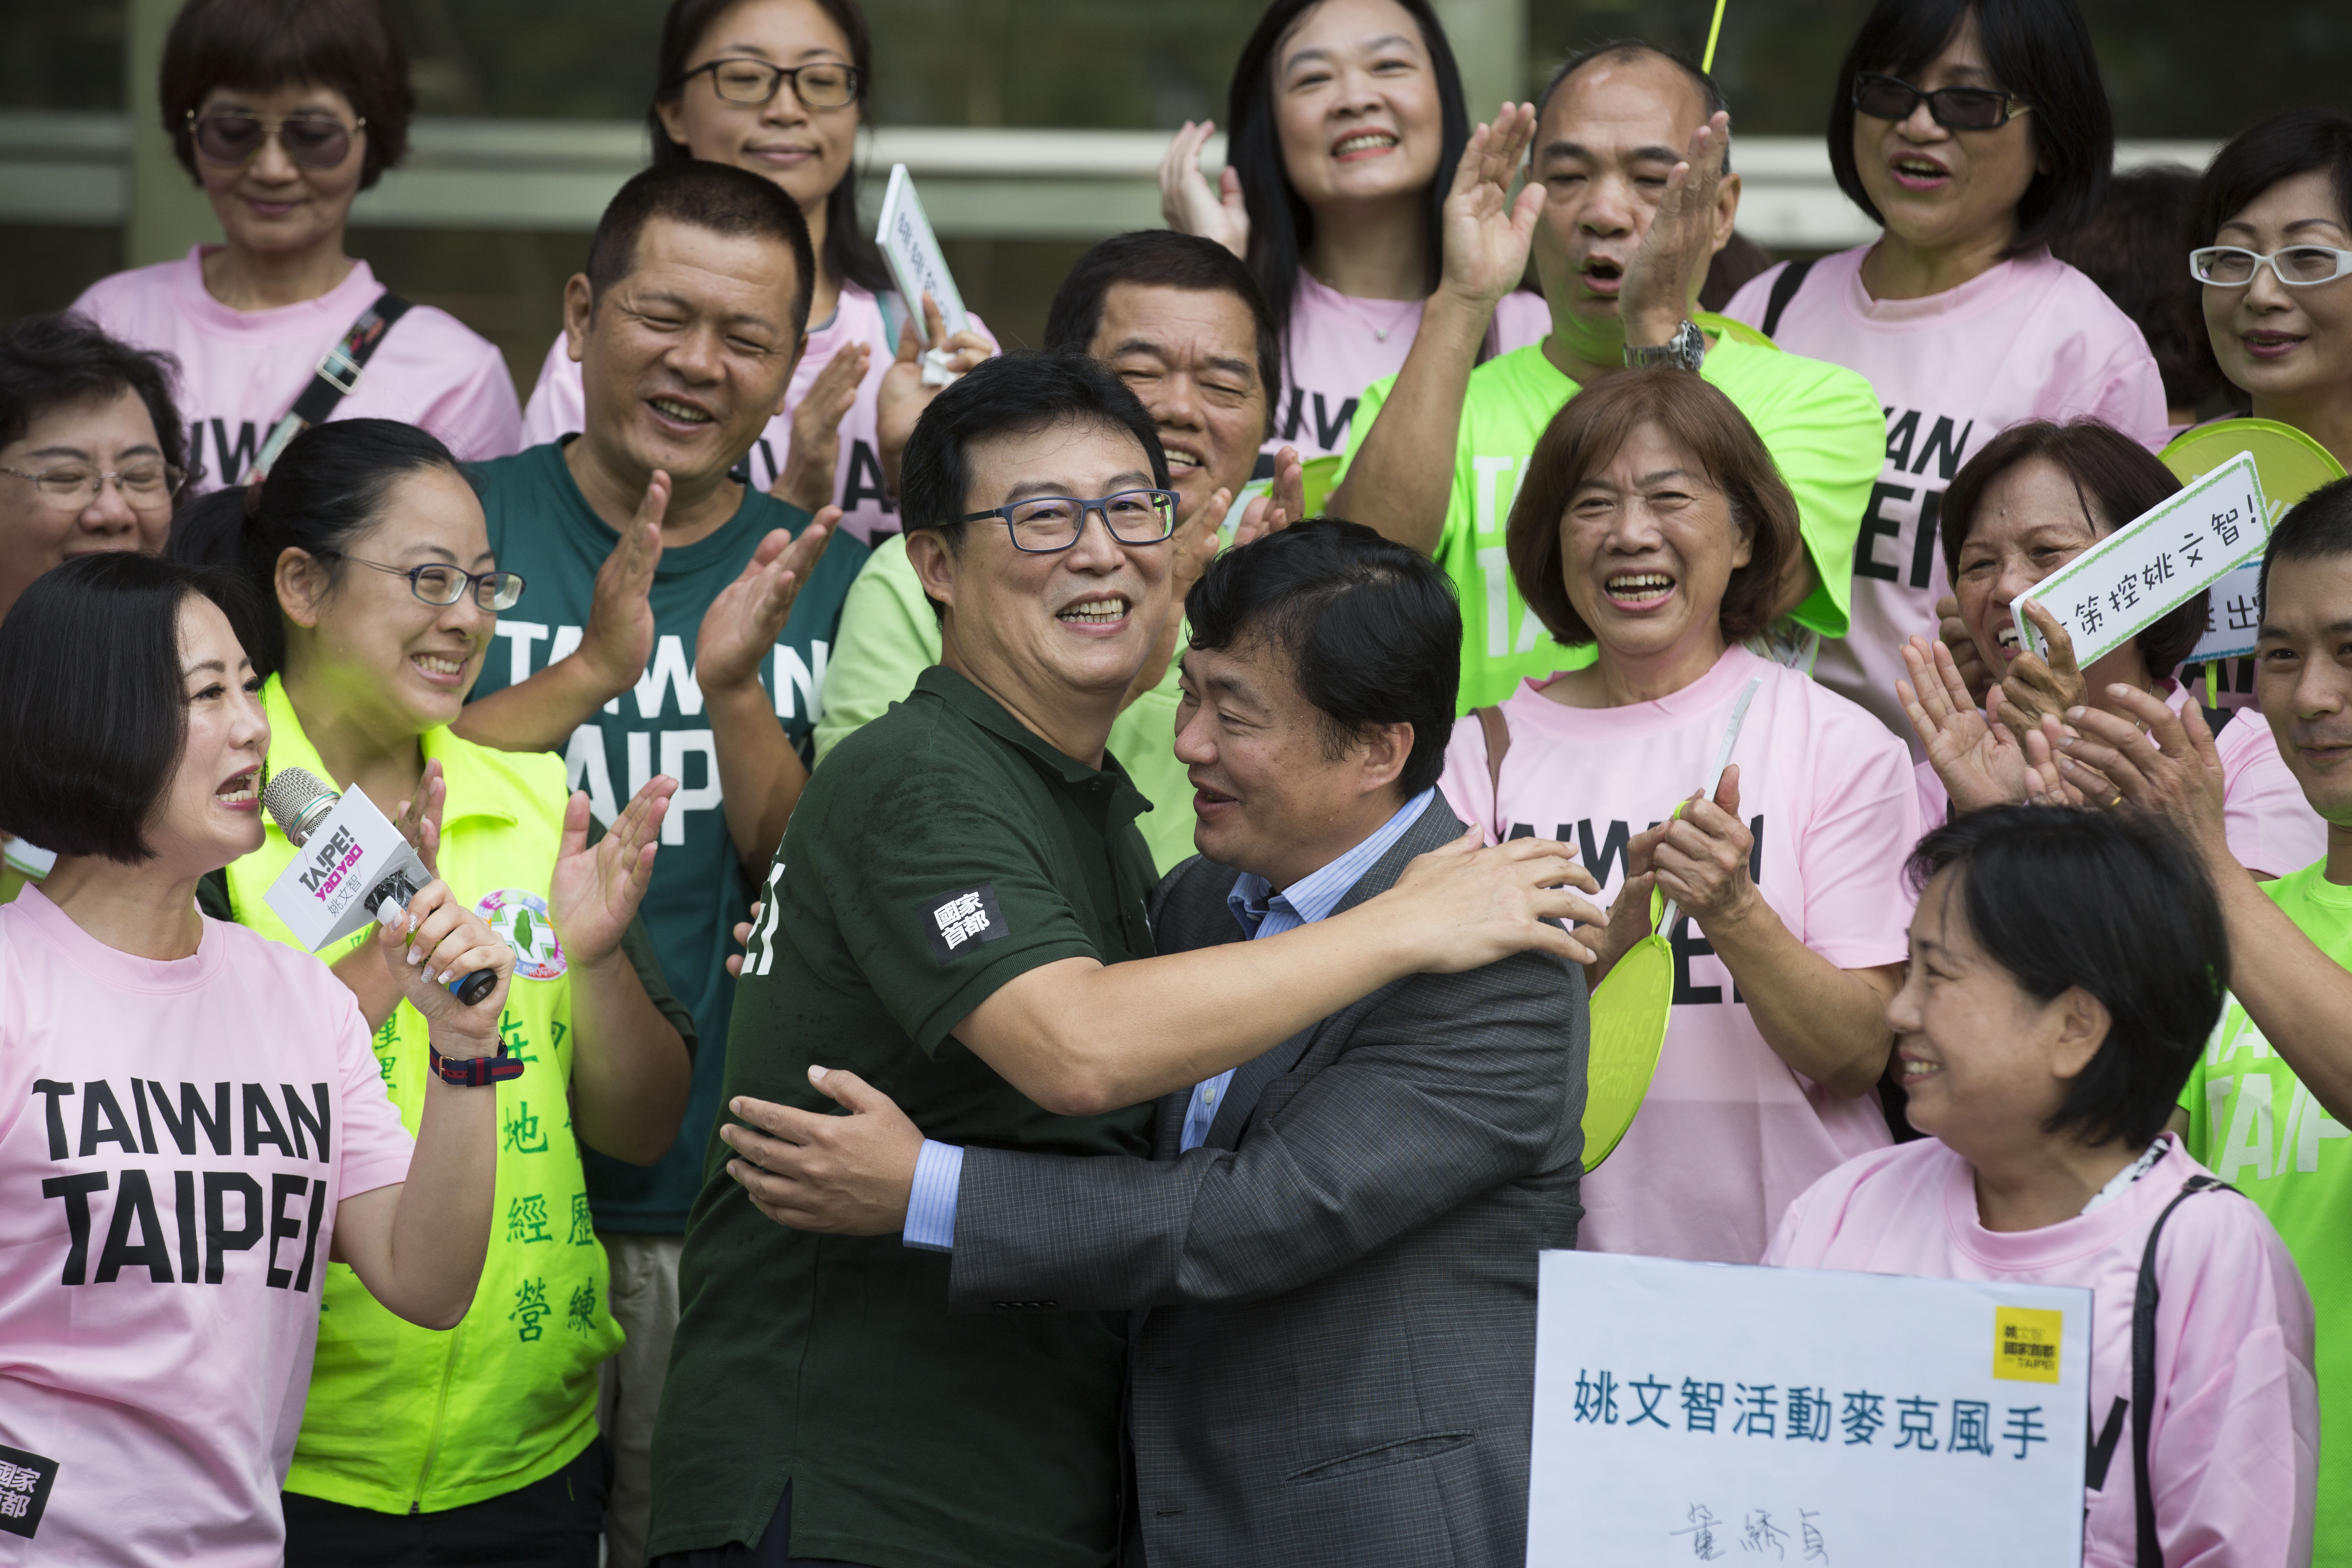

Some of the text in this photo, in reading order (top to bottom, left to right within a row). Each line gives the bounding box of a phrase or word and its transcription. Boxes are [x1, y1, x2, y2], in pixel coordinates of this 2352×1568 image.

[2040, 494, 2256, 657] 策控姚文智!
[495, 620, 829, 723] TWN
[327, 874, 362, 918] 姚文智
[933, 891, 983, 931] 國家
[941, 909, 990, 950] 首都
[33, 1077, 331, 1163] TAIWAN
[2206, 1072, 2352, 1184] TAIP
[499, 1010, 552, 1343] 在地經營
[42, 1169, 327, 1293] TAIPEI
[1573, 1368, 2049, 1460] 姚文智活動麥克風手
[0, 1488, 31, 1518] 都
